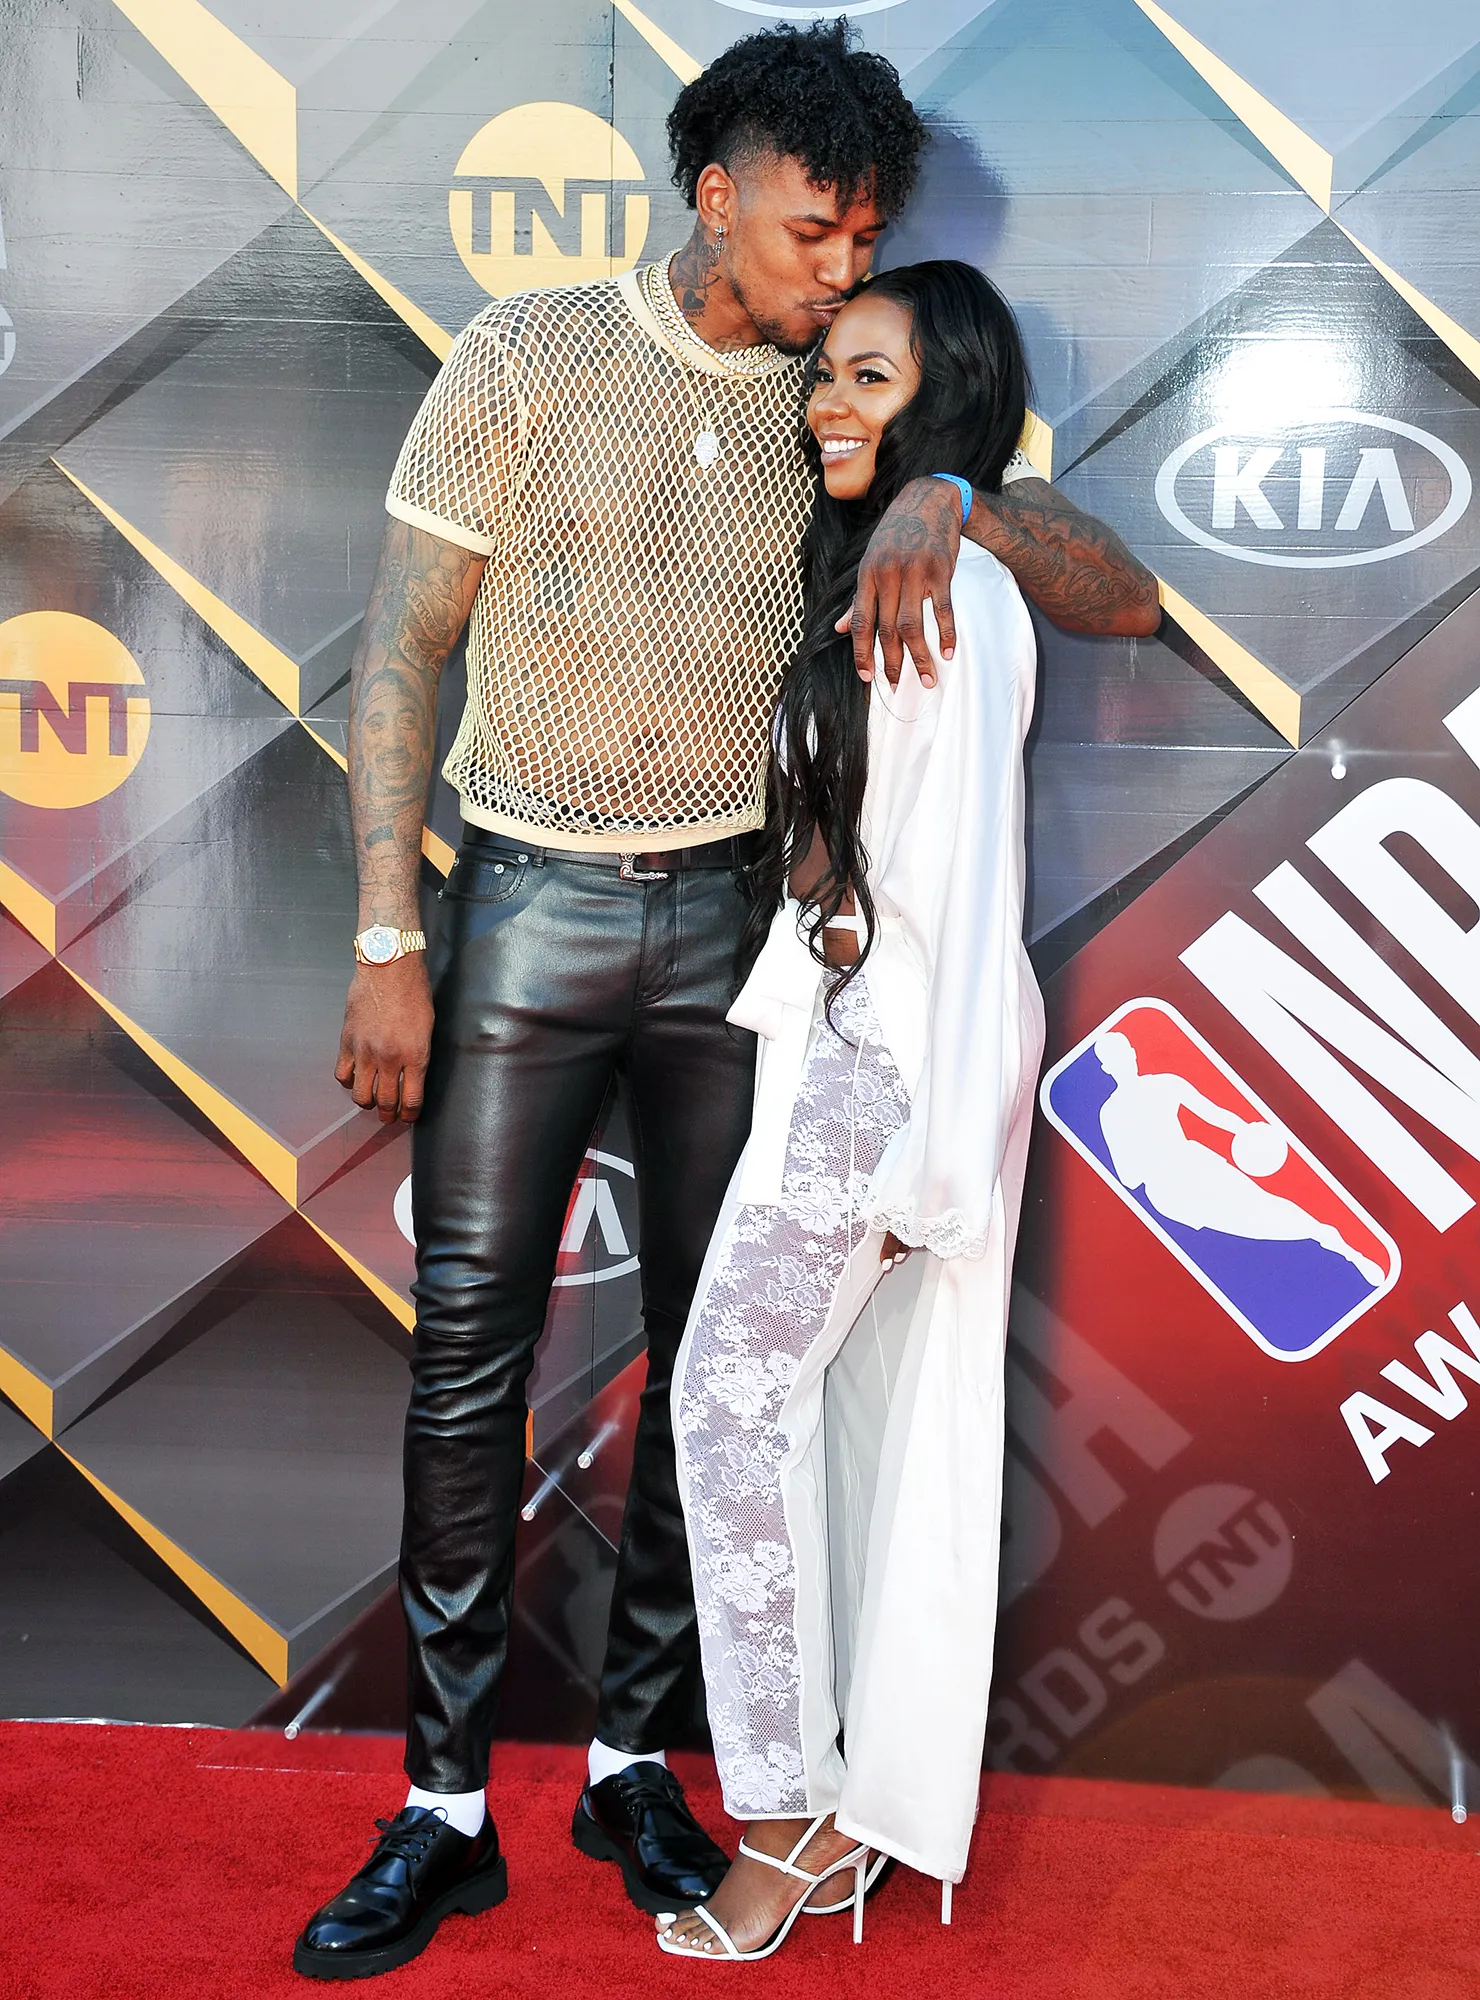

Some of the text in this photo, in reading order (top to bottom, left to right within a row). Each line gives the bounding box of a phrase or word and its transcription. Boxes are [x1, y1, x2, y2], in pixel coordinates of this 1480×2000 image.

[450, 175, 649, 258] TNT
[1211, 447, 1415, 531] KIA
[1162, 1494, 1282, 1608] TNT
